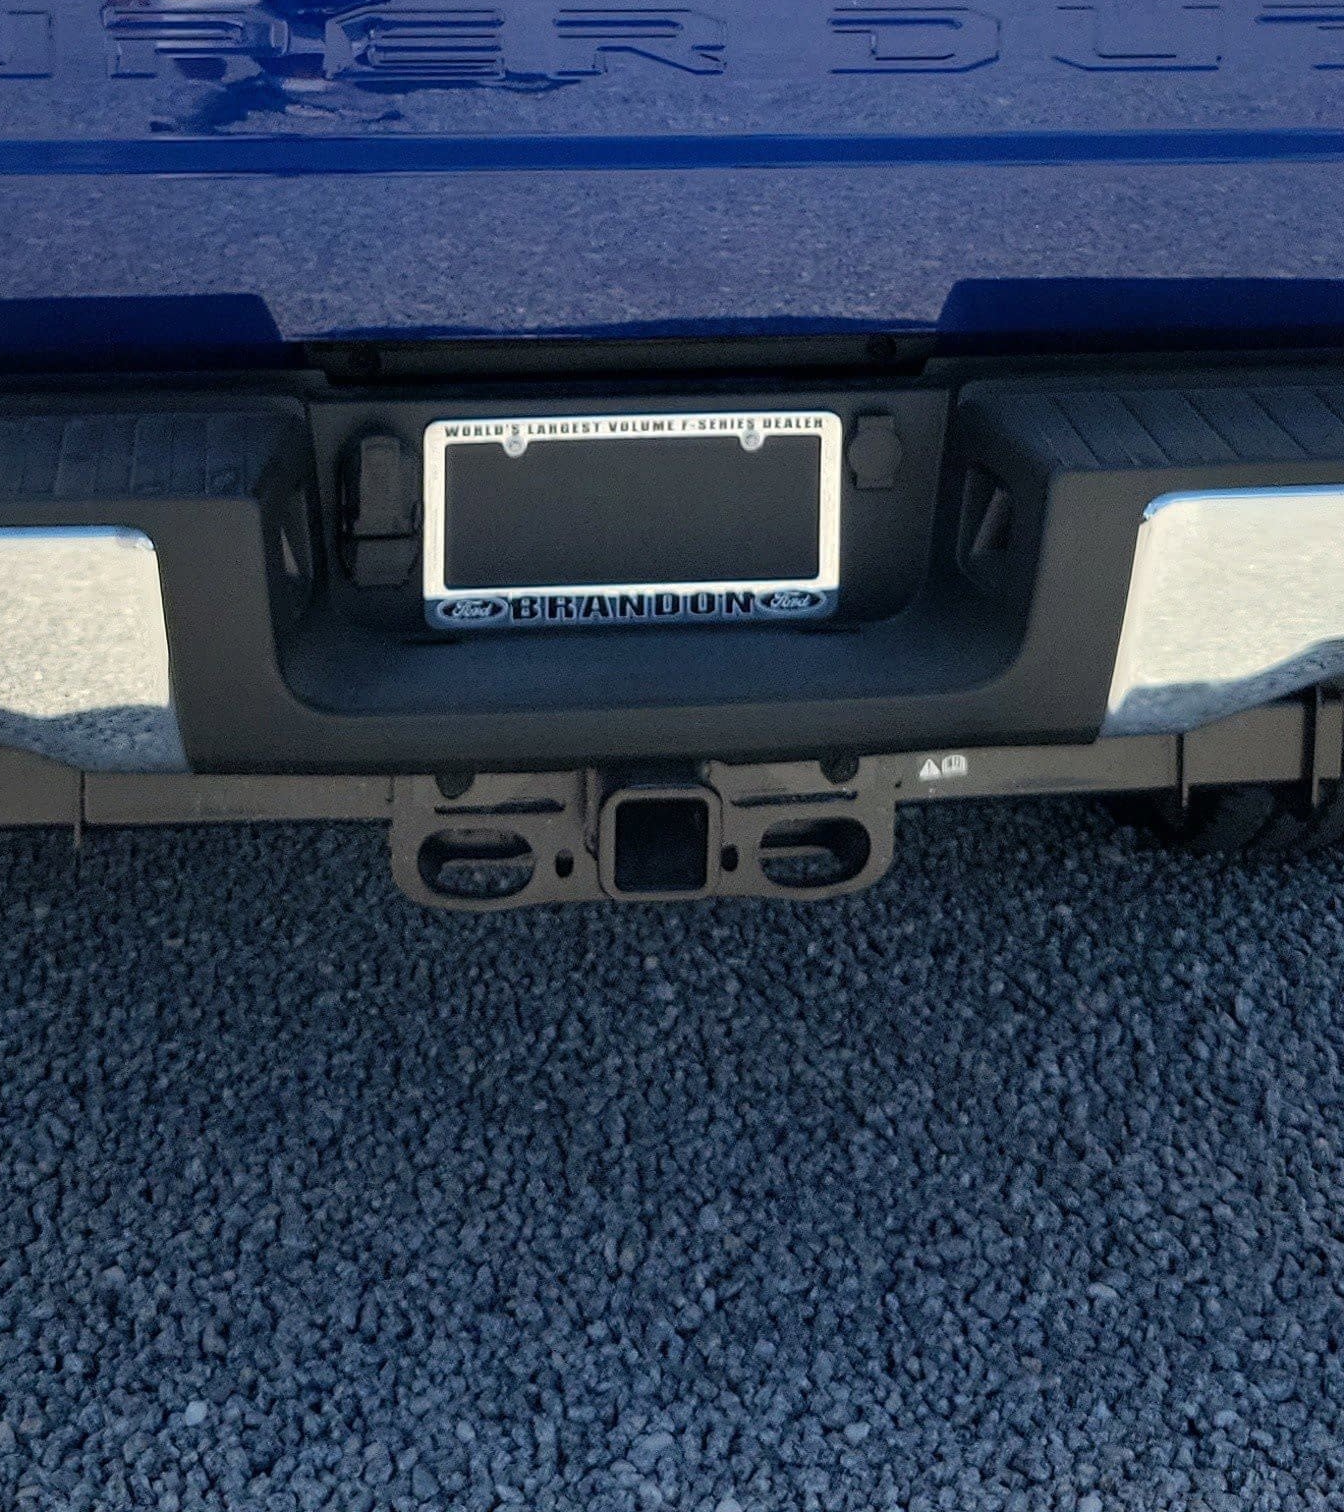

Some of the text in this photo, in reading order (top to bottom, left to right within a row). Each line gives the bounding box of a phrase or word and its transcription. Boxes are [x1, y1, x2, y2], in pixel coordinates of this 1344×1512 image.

[444, 416, 823, 437] WORLD'S LARGEST VOLUME F-SERIES DEALER
[451, 590, 811, 621] Ford BRANDON Ford
